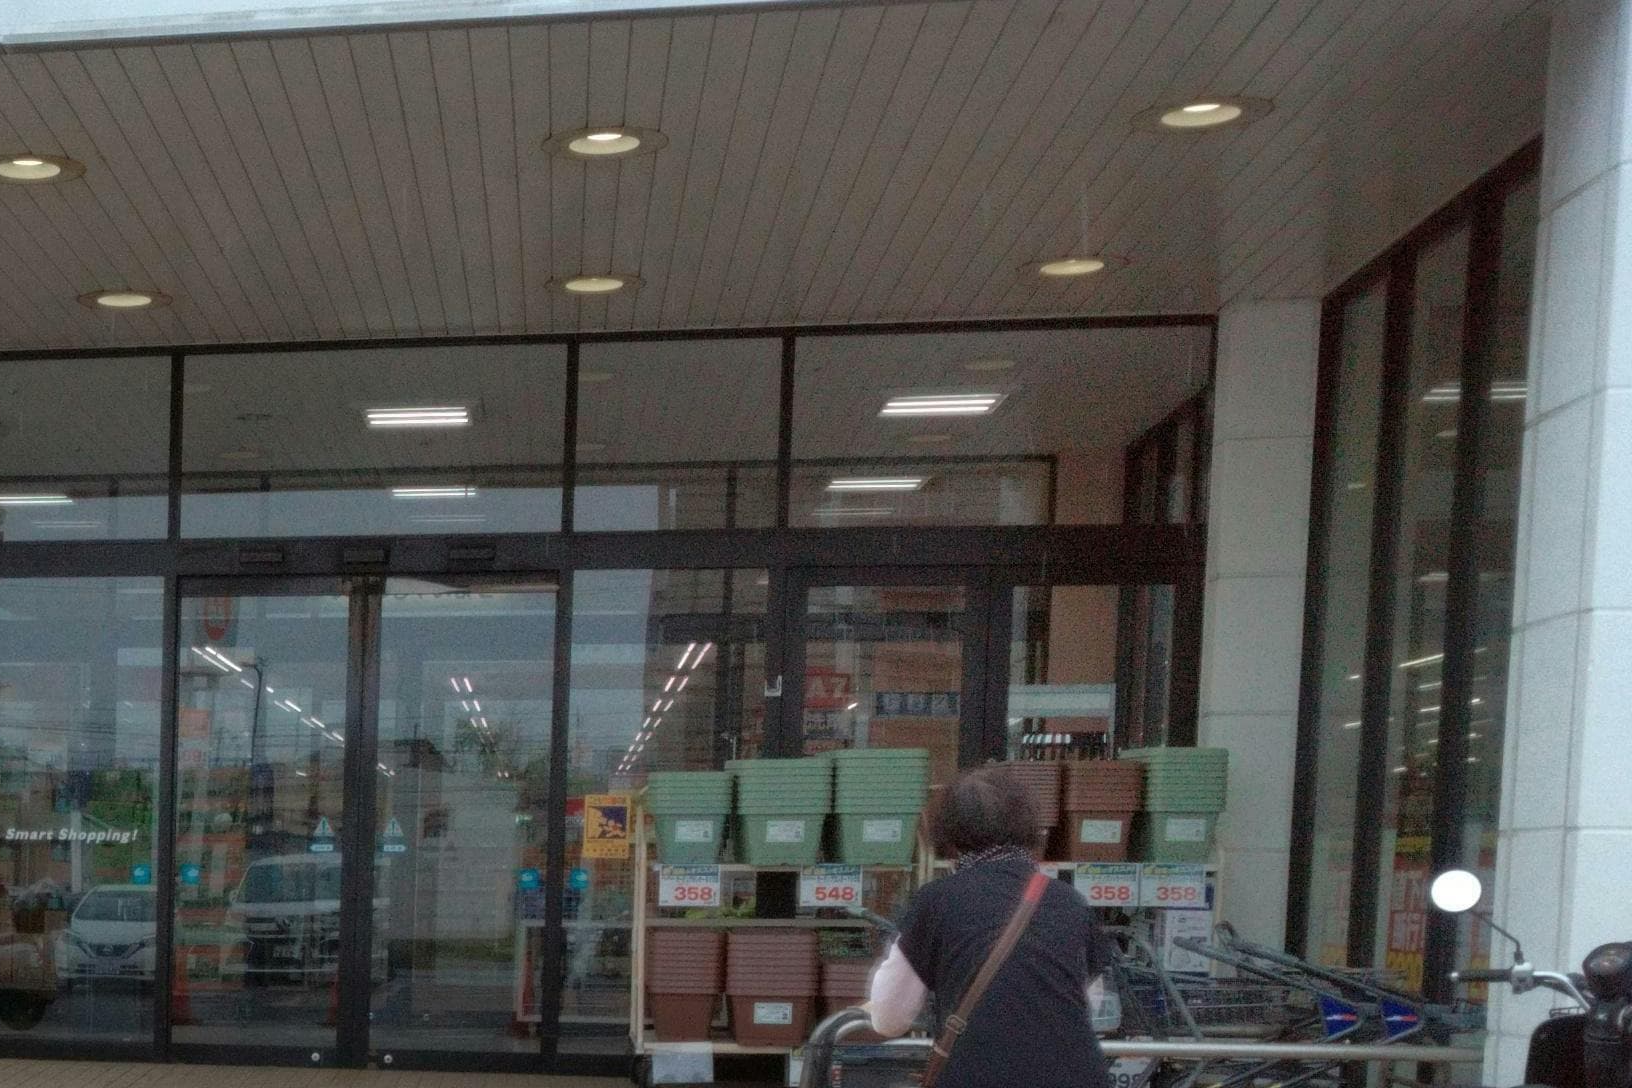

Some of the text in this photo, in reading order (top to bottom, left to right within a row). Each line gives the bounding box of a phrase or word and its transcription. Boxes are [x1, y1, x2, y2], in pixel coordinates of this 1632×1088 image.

[5, 828, 138, 844] Smart Shopping!
[674, 886, 713, 901] 358
[815, 886, 854, 901] 548
[1090, 885, 1130, 900] 358
[1157, 886, 1197, 900] 358
